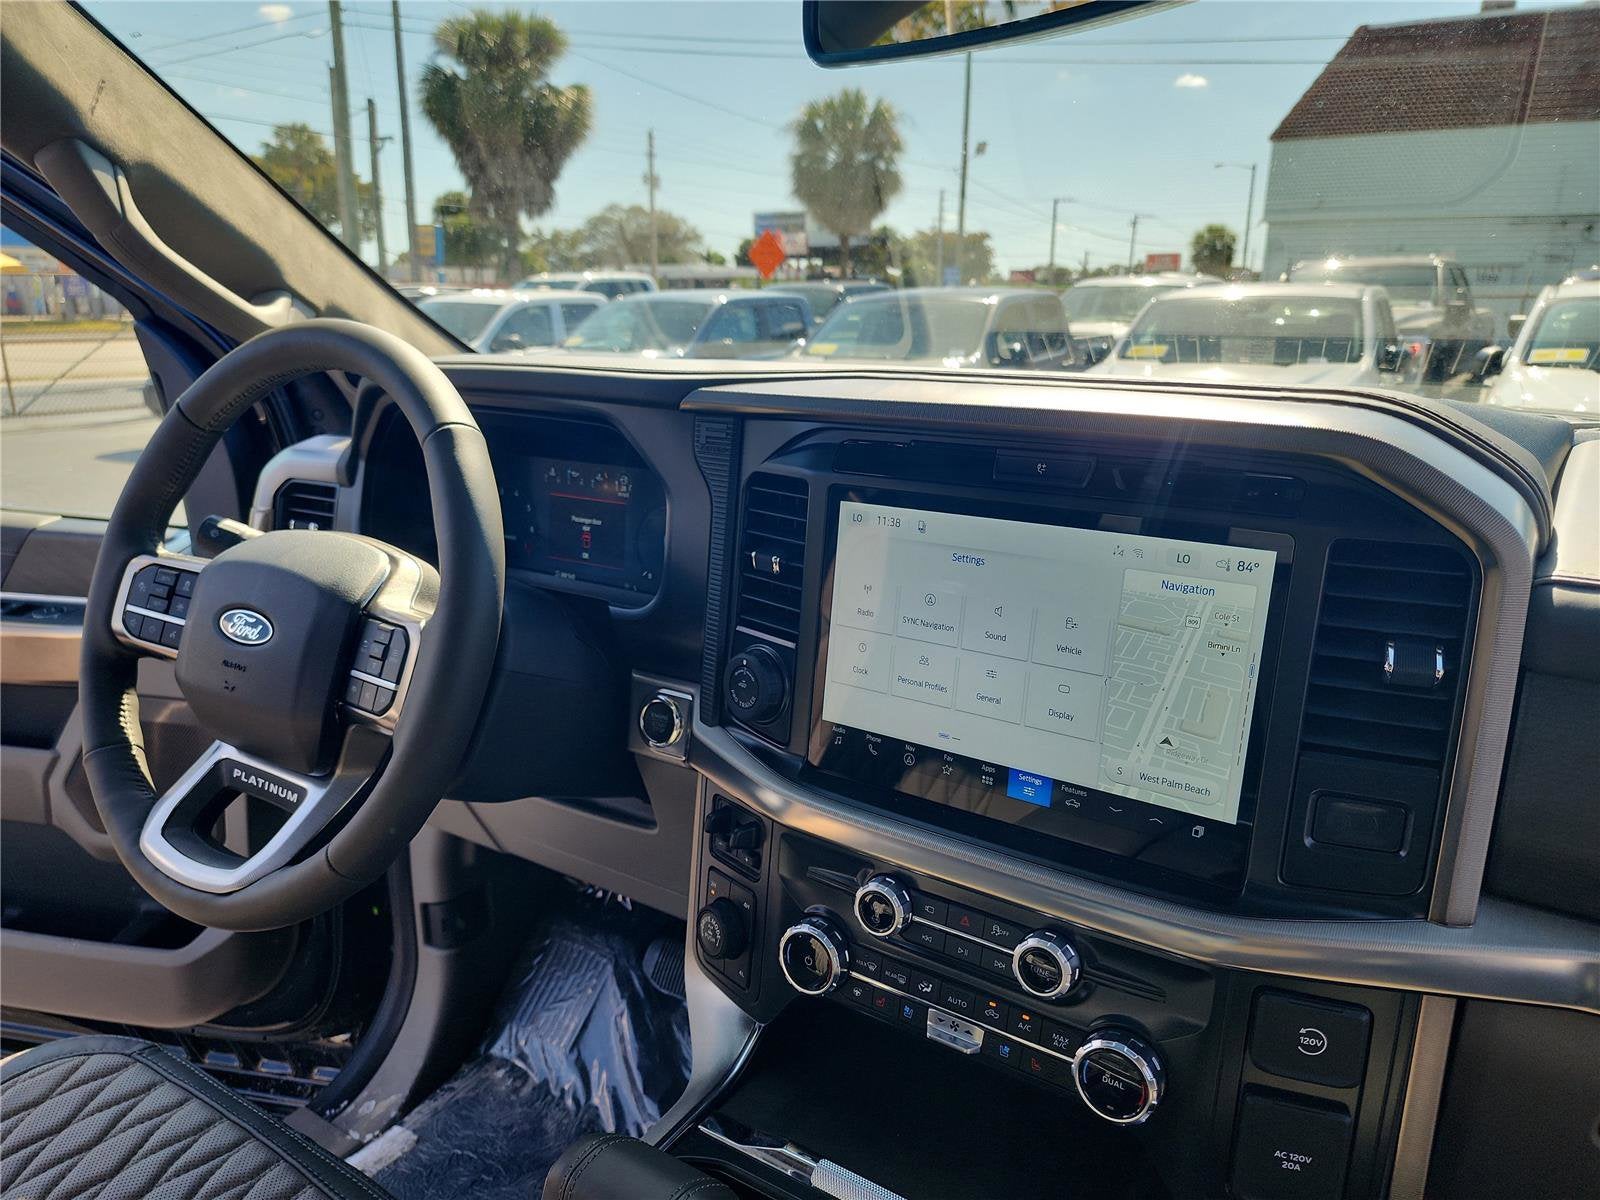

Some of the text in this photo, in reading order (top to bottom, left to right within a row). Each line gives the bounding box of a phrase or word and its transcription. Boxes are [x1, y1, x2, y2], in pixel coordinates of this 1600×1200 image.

[852, 513, 863, 523] LO
[877, 516, 901, 528] 11:38
[952, 552, 985, 567] Settings
[1176, 554, 1191, 564] LO
[1237, 560, 1260, 573] 84°
[1161, 579, 1216, 597] Navigation
[857, 607, 874, 618] Radio
[1214, 611, 1240, 623] Cole St
[229, 614, 263, 639] Ford
[902, 616, 955, 633] SYNC Navigation
[984, 631, 1007, 642] Sound
[1056, 644, 1082, 656] Vehicle
[1207, 641, 1241, 653] Bimini Ln
[852, 665, 869, 676] Clock
[897, 675, 948, 694] Personal Profiles
[976, 692, 1002, 705] General
[1048, 708, 1075, 722] Display
[831, 725, 846, 735] Audio
[865, 734, 882, 744] Phone
[905, 744, 916, 752] Nav
[943, 753, 954, 762] Fav
[981, 764, 996, 774] Apps
[1116, 766, 1123, 776] S
[233, 768, 299, 803] PLATINUM
[1018, 773, 1043, 786] Settings
[1139, 772, 1211, 797] West Palm Beach
[1061, 784, 1088, 797] Features
[1030, 965, 1049, 977] TUNE
[947, 995, 968, 1008] AUTO
[1018, 1022, 1033, 1033] A/C
[1052, 1033, 1070, 1044] MAX
[1299, 1036, 1323, 1047] 120V
[1053, 1040, 1068, 1050] A/C
[1102, 1075, 1125, 1091] DUAL
[1274, 1150, 1313, 1164] AC 120V
[1281, 1161, 1302, 1172] 20A
